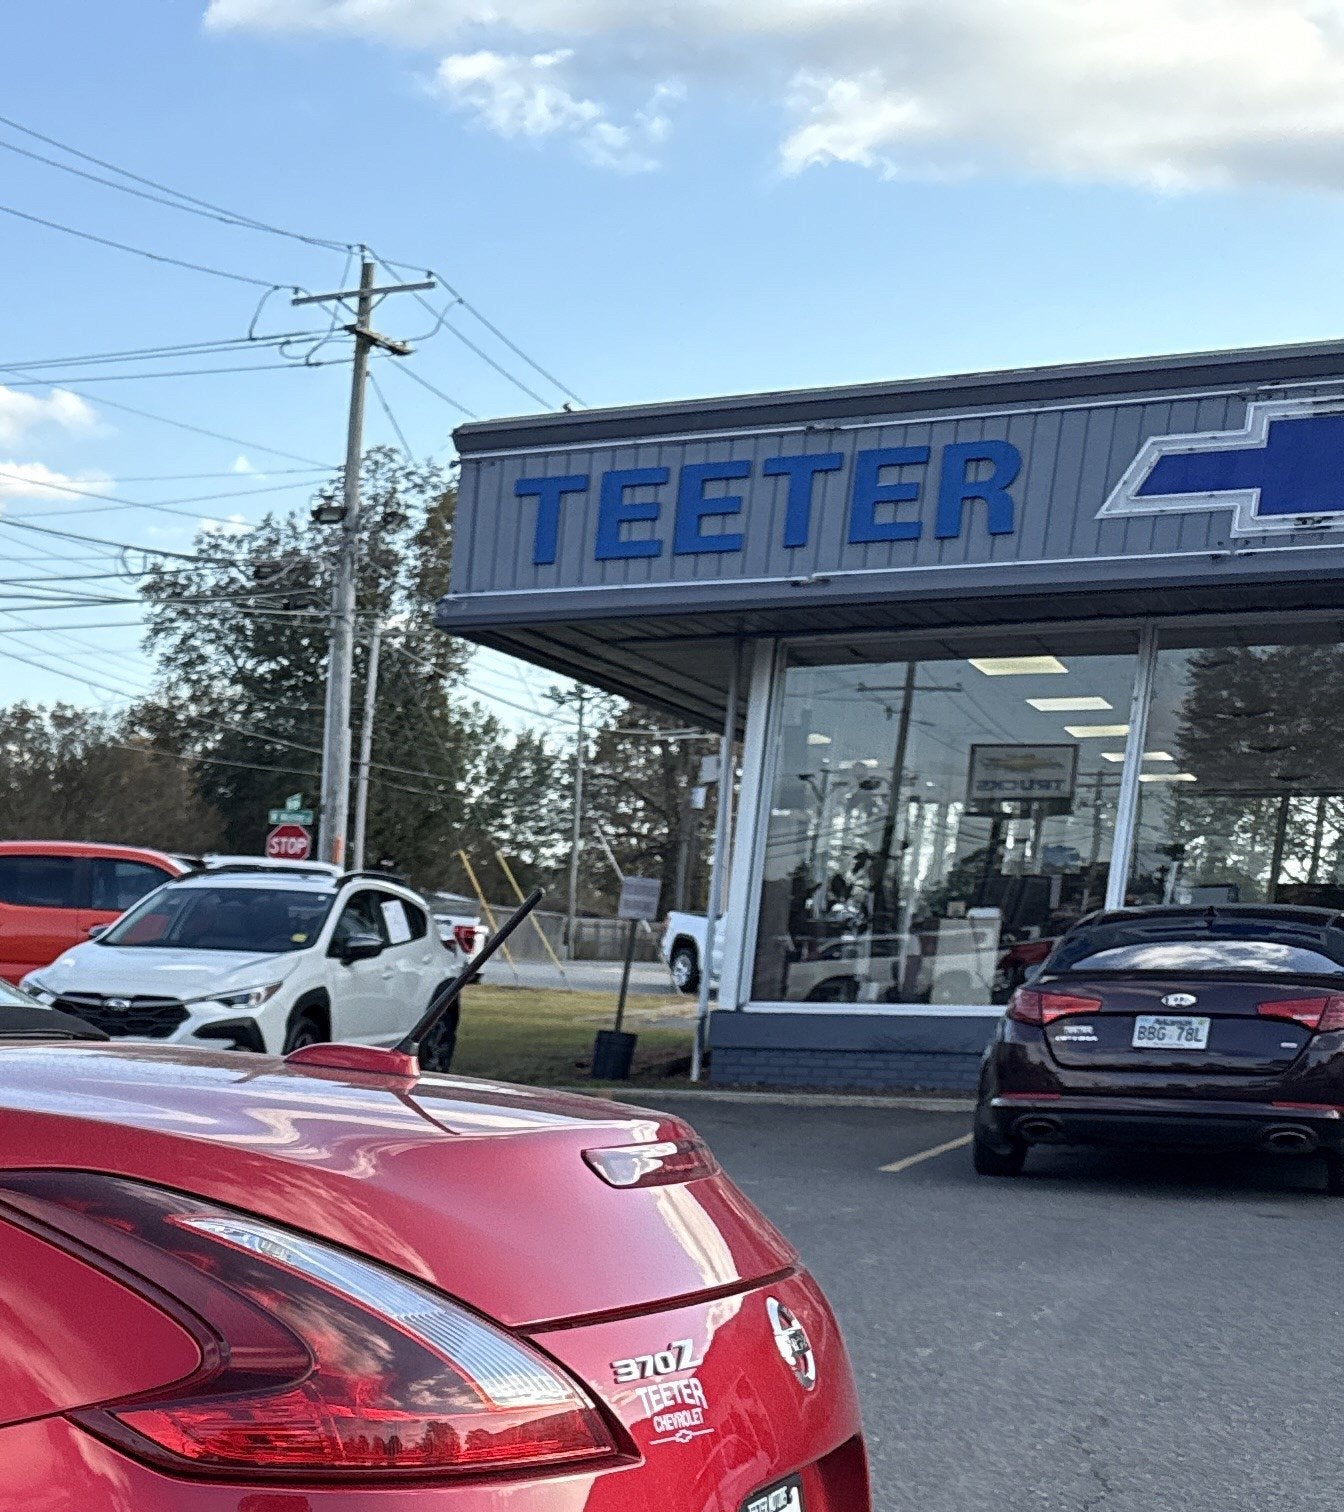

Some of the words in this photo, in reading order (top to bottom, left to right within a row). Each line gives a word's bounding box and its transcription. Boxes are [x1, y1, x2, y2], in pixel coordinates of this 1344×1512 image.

[515, 440, 1022, 565] TEETER
[268, 836, 307, 855] STOP
[612, 1338, 704, 1384] 370Z
[635, 1377, 708, 1418] TEETER
[653, 1407, 704, 1433] CHEVROLET
